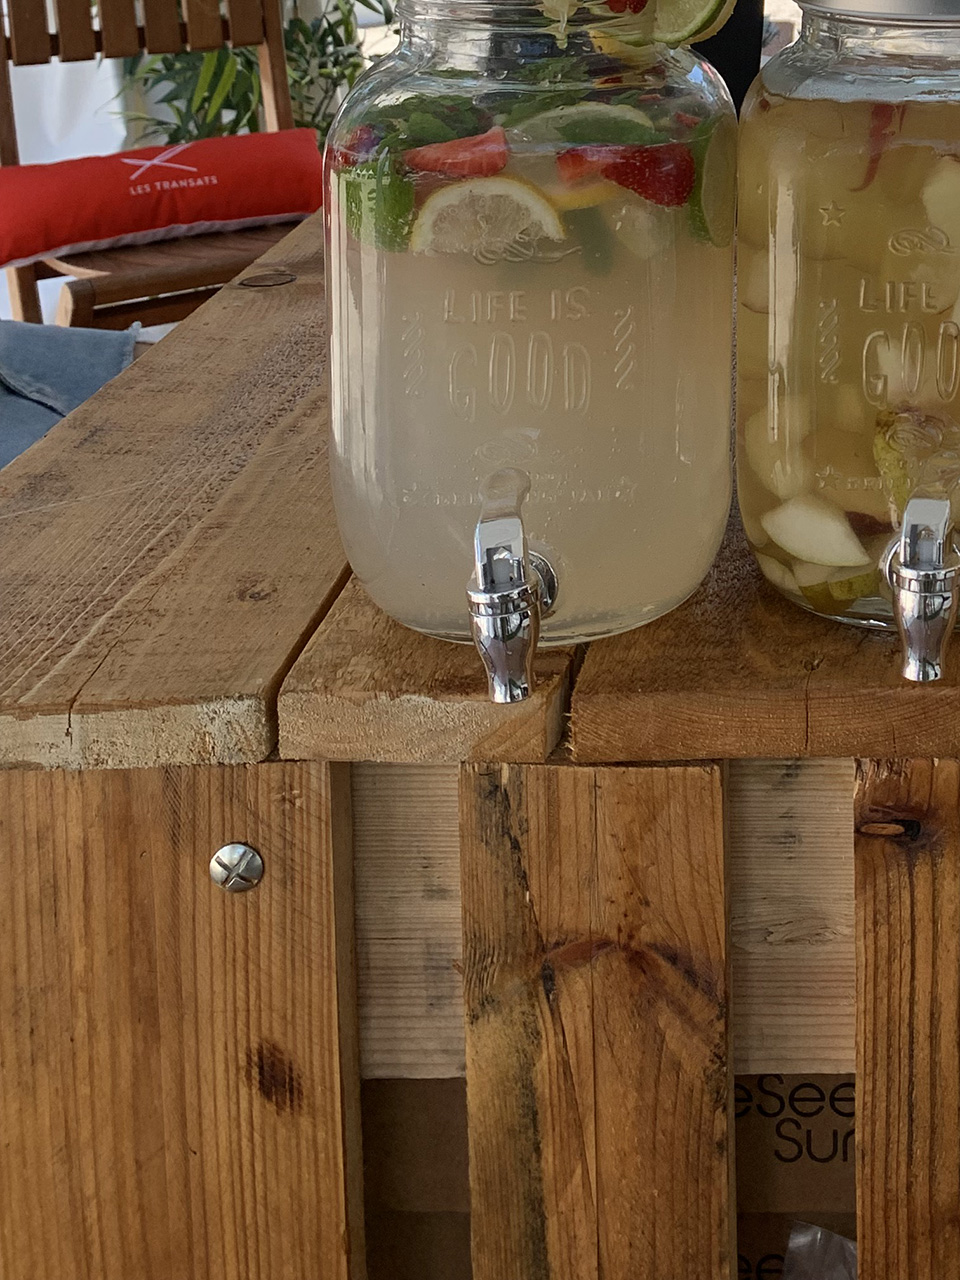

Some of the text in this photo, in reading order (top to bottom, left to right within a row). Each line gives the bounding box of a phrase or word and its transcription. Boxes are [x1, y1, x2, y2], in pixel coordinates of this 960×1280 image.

[129, 175, 218, 196] LES TRANSATS
[443, 285, 590, 326] LIFE IS
[858, 277, 938, 314] LIFE
[447, 330, 592, 421] GOOD
